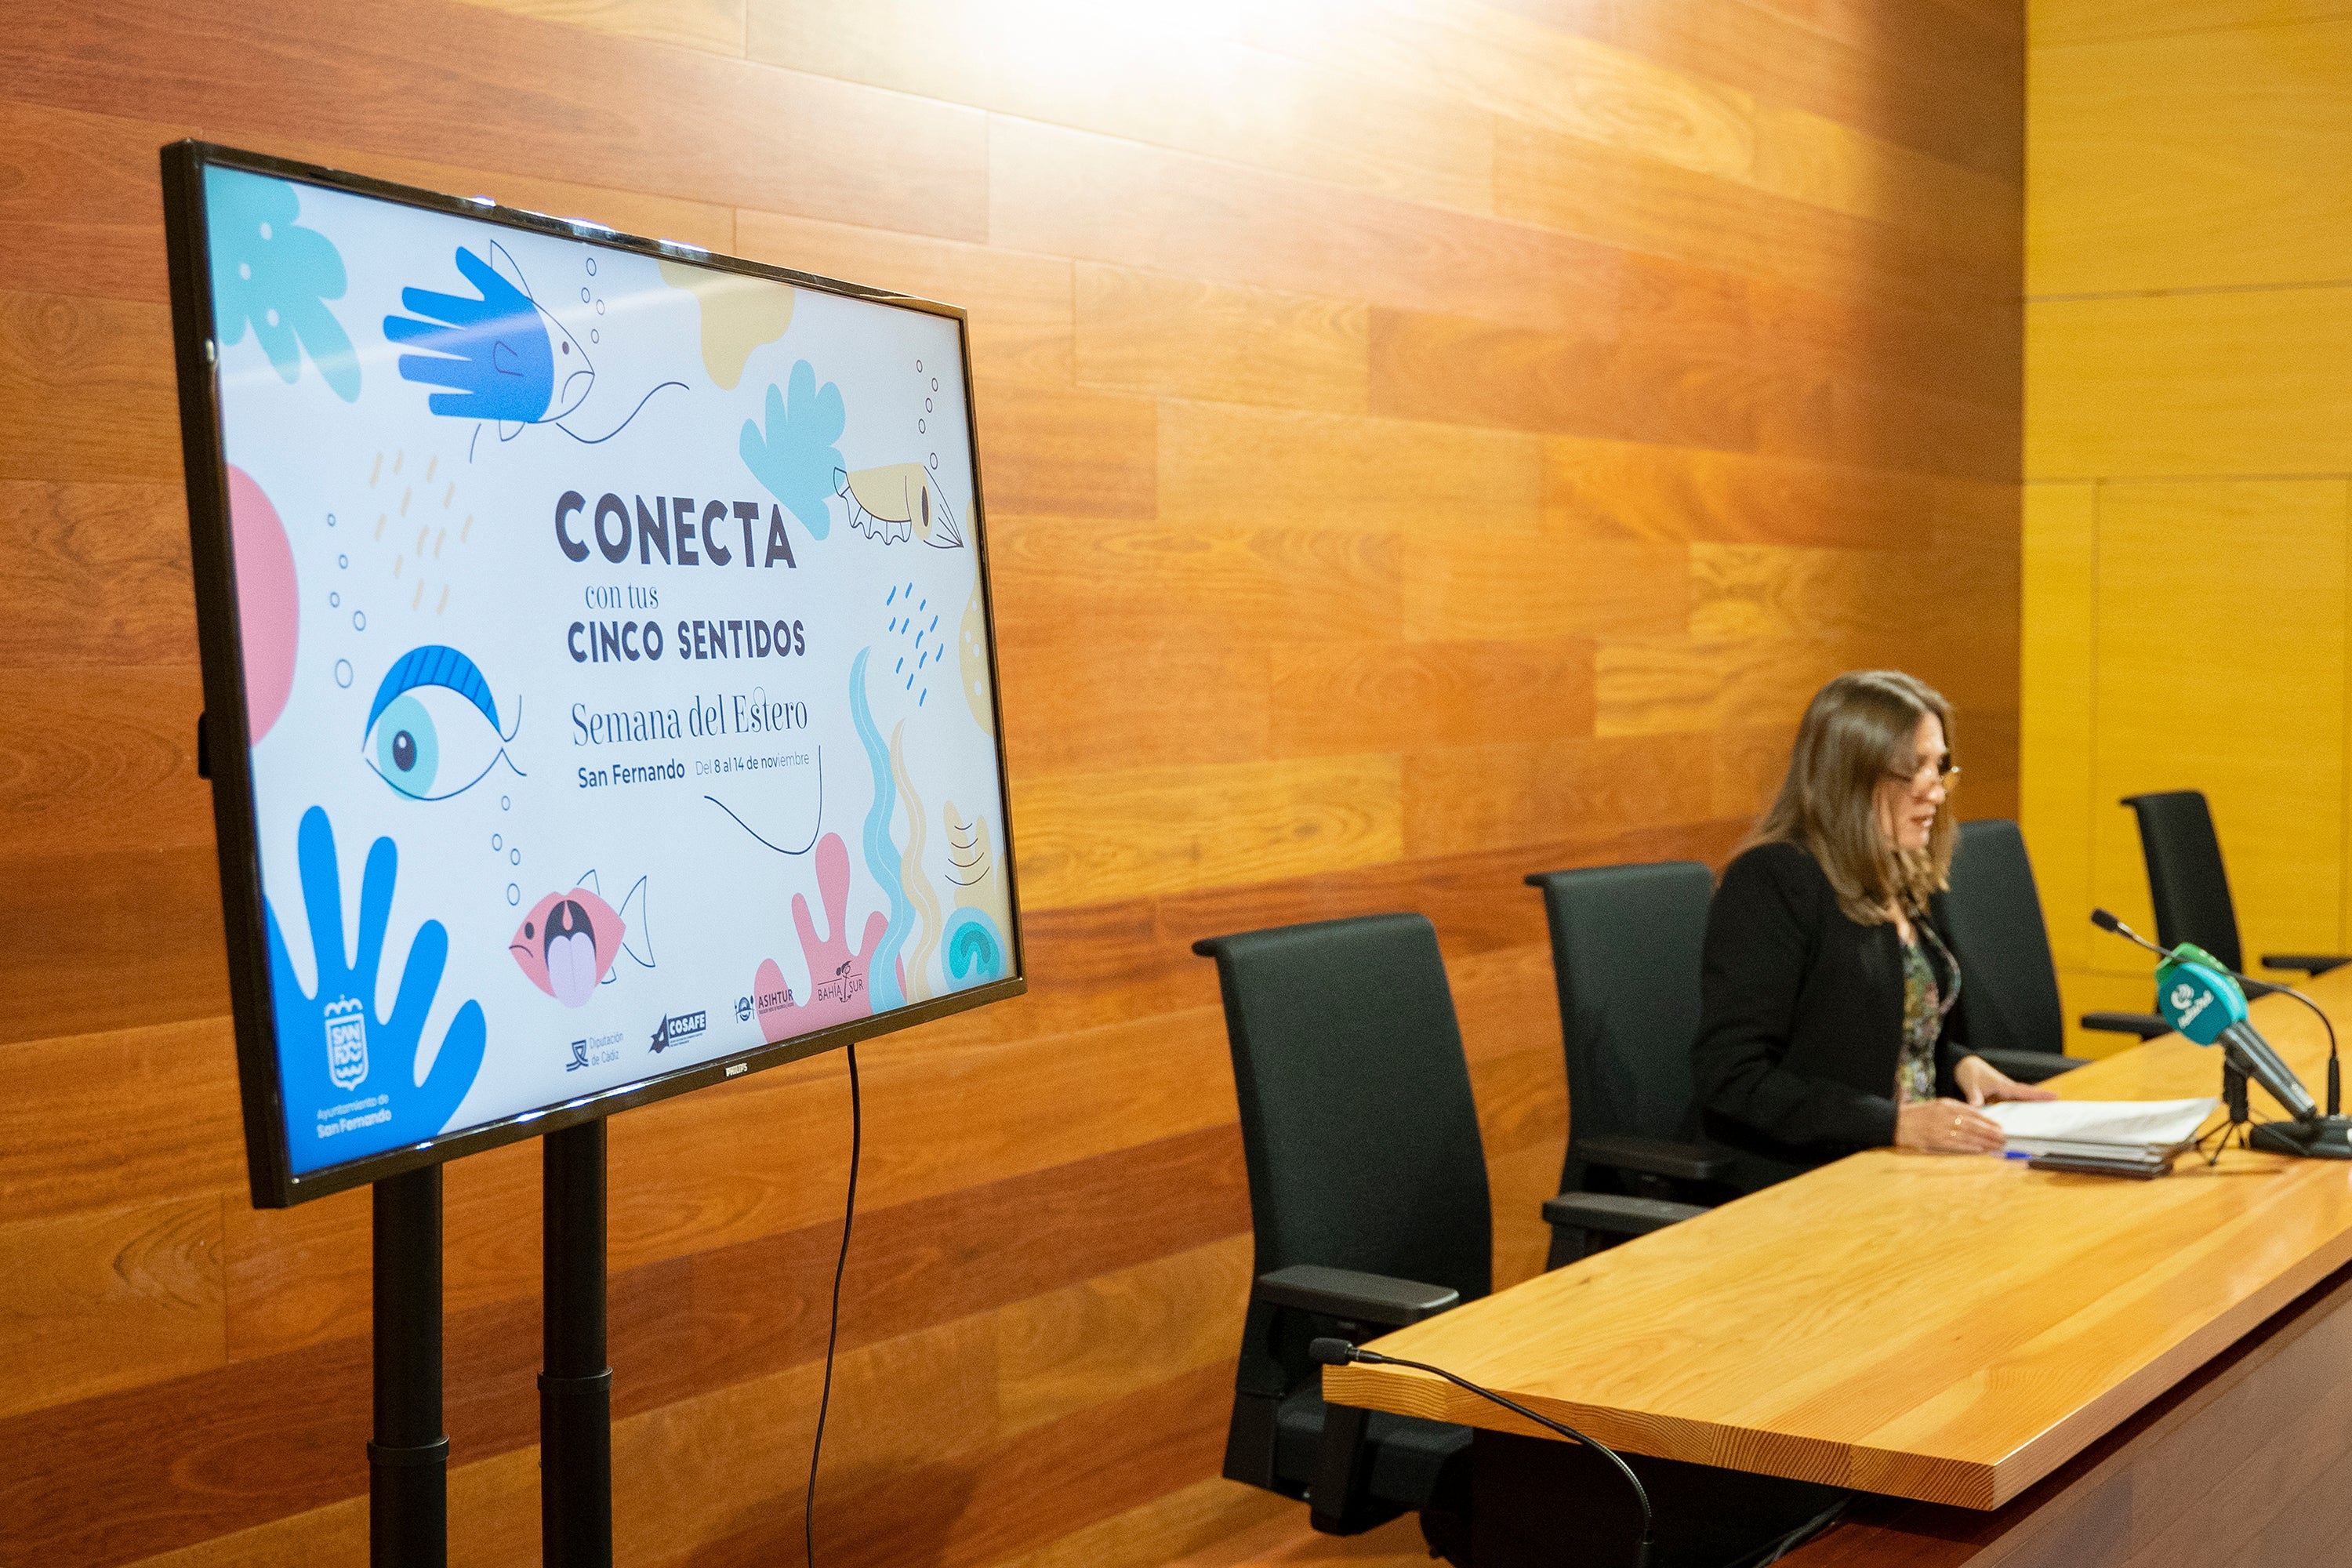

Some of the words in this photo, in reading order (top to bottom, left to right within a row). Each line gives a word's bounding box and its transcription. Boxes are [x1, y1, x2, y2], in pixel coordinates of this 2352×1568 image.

[554, 490, 797, 569] CONECTA
[585, 583, 622, 609] con
[628, 582, 659, 609] tus
[568, 620, 664, 663] CINCO
[677, 619, 806, 660] SENTIDOS
[572, 702, 683, 746] Semana
[689, 694, 726, 738] del
[732, 686, 808, 735] Estero
[578, 767, 608, 788] San
[612, 758, 686, 785] Fernando
[695, 760, 712, 776] Del
[714, 759, 721, 774] 8
[723, 757, 732, 773] al
[733, 757, 745, 771] 14
[746, 754, 759, 770] de
[760, 751, 811, 770] noviembre
[758, 989, 794, 1009] ASIHTUR
[818, 982, 843, 1002] BAHÍA
[849, 978, 865, 993] SUR
[669, 1014, 706, 1036] COSAFE
[590, 1032, 624, 1050] Diputación
[591, 1054, 600, 1066] de
[601, 1049, 619, 1064] Cádiz
[725, 1062, 748, 1077] PHILIPS
[317, 1123, 339, 1138] San
[339, 1108, 392, 1131] Fernando
